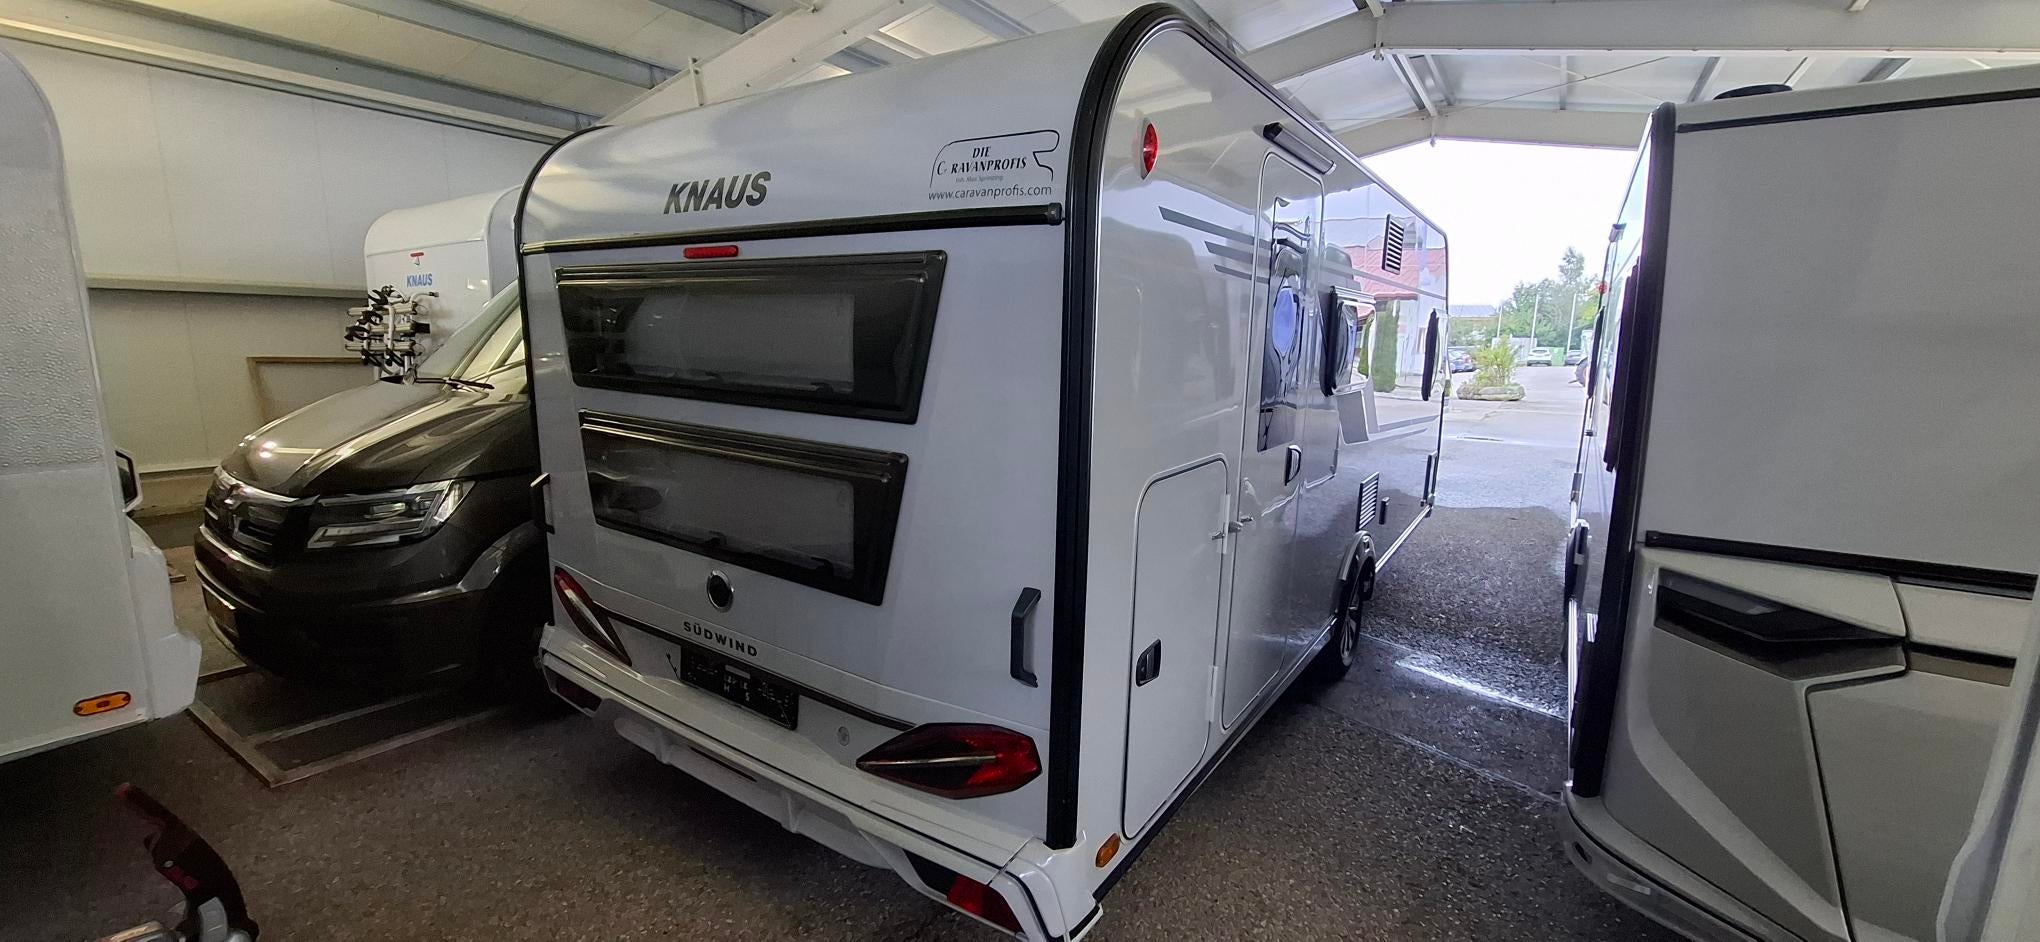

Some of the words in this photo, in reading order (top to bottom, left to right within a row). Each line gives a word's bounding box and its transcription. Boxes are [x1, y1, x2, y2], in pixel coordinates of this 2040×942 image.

[972, 146, 992, 158] DIE
[936, 156, 1027, 175] CRAVANPROFIS
[663, 171, 771, 214] KNAUS
[928, 184, 1052, 200] www.caravanprofis.com
[406, 273, 433, 288] KNAUS
[683, 621, 758, 657] SÜDWIND
